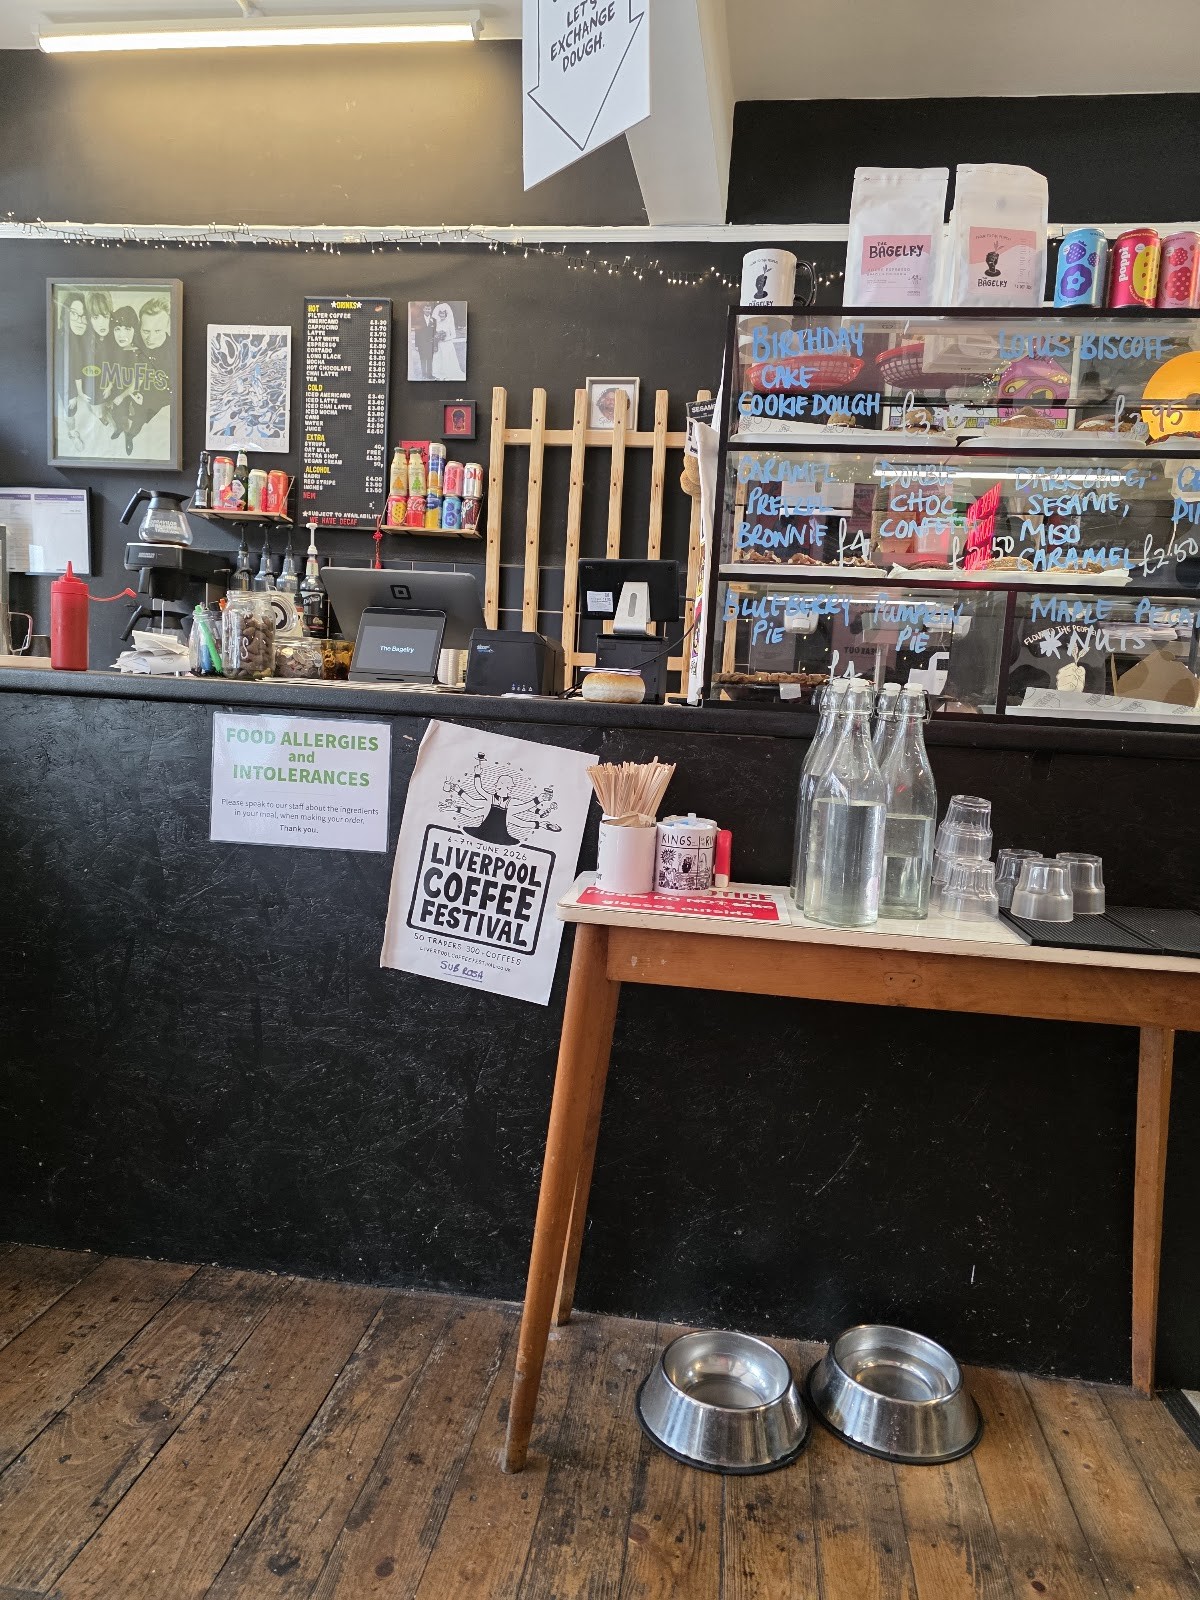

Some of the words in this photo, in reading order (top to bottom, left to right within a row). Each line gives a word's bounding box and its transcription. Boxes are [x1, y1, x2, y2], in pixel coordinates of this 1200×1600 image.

[550, 1, 616, 61] EXCHANGE
[562, 32, 604, 72] DOUGH.
[869, 244, 924, 258] BAGELRY
[978, 278, 1008, 288] BAGELRY
[308, 304, 320, 312] HOT
[336, 302, 357, 310] DRINKS
[752, 322, 864, 363] BIRTHDAY
[998, 328, 1070, 360] LOTUS
[1080, 334, 1172, 361] BISCOFF
[84, 367, 98, 375] the
[762, 364, 822, 388] CAKE
[738, 392, 808, 418] COOKIE
[810, 393, 880, 417] DOUGH
[306, 466, 331, 474] ALCOHOL
[737, 455, 838, 485] CARAMEL
[1014, 466, 1082, 492] DARK
[748, 486, 834, 517] PRETZEL
[890, 488, 958, 516] CHOC
[1020, 519, 1080, 546] MISO
[1016, 546, 1137, 572] CARAMEL
[722, 588, 850, 627] BLUEBERRY
[1030, 594, 1114, 625] MAPLE
[752, 620, 786, 646] PIE
[895, 624, 930, 653] PIE
[1055, 625, 1071, 634] THE
[1067, 625, 1145, 657] NUTS
[392, 646, 415, 654] Bagelry
[226, 728, 276, 745] FOOD
[280, 732, 379, 752] ALLERGIES
[288, 751, 315, 764] and
[233, 764, 370, 787] INTOLERANCES
[221, 798, 244, 807] Please
[245, 800, 266, 809] speak
[289, 802, 304, 810] staff
[305, 803, 326, 811] about
[340, 805, 379, 816] ingredients
[260, 811, 278, 819] meal,
[280, 812, 299, 820] when
[301, 814, 326, 824] making
[327, 816, 343, 824] your
[280, 824, 301, 832] Thank
[303, 826, 319, 834] you.
[662, 833, 692, 846] KINGS
[476, 842, 500, 855] JUNE
[503, 848, 528, 861] 2026
[430, 842, 542, 888] LIVERPOOL
[424, 866, 536, 922] COFFEE
[586, 888, 649, 899] Please
[687, 898, 726, 907] NOT
[706, 890, 774, 901] OTICE
[601, 900, 675, 910] glasses
[681, 906, 754, 917] outside
[420, 898, 528, 948] FESTIVAL
[414, 932, 425, 941] 50
[427, 936, 462, 950] TRADERS
[440, 960, 460, 972] SUB
[462, 966, 484, 980] ROSA
